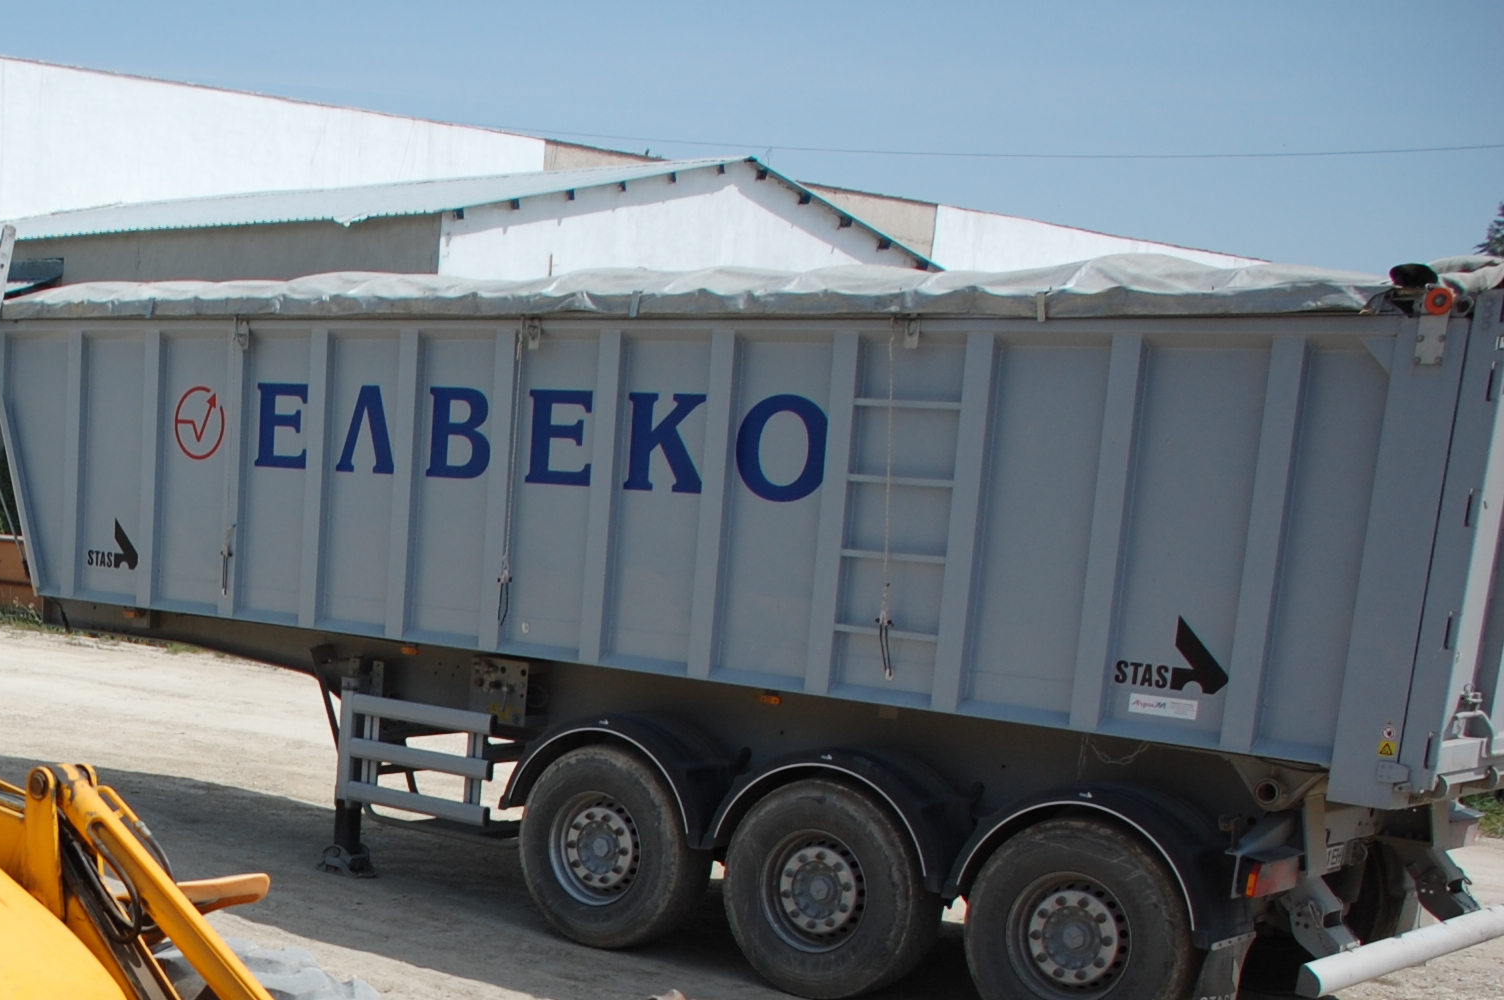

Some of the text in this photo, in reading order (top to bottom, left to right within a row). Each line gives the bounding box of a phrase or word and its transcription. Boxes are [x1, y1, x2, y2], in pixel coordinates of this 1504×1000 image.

[254, 381, 829, 503] ЕЛВЕКО
[87, 549, 113, 569] STAS
[1114, 660, 1168, 690] STAS
